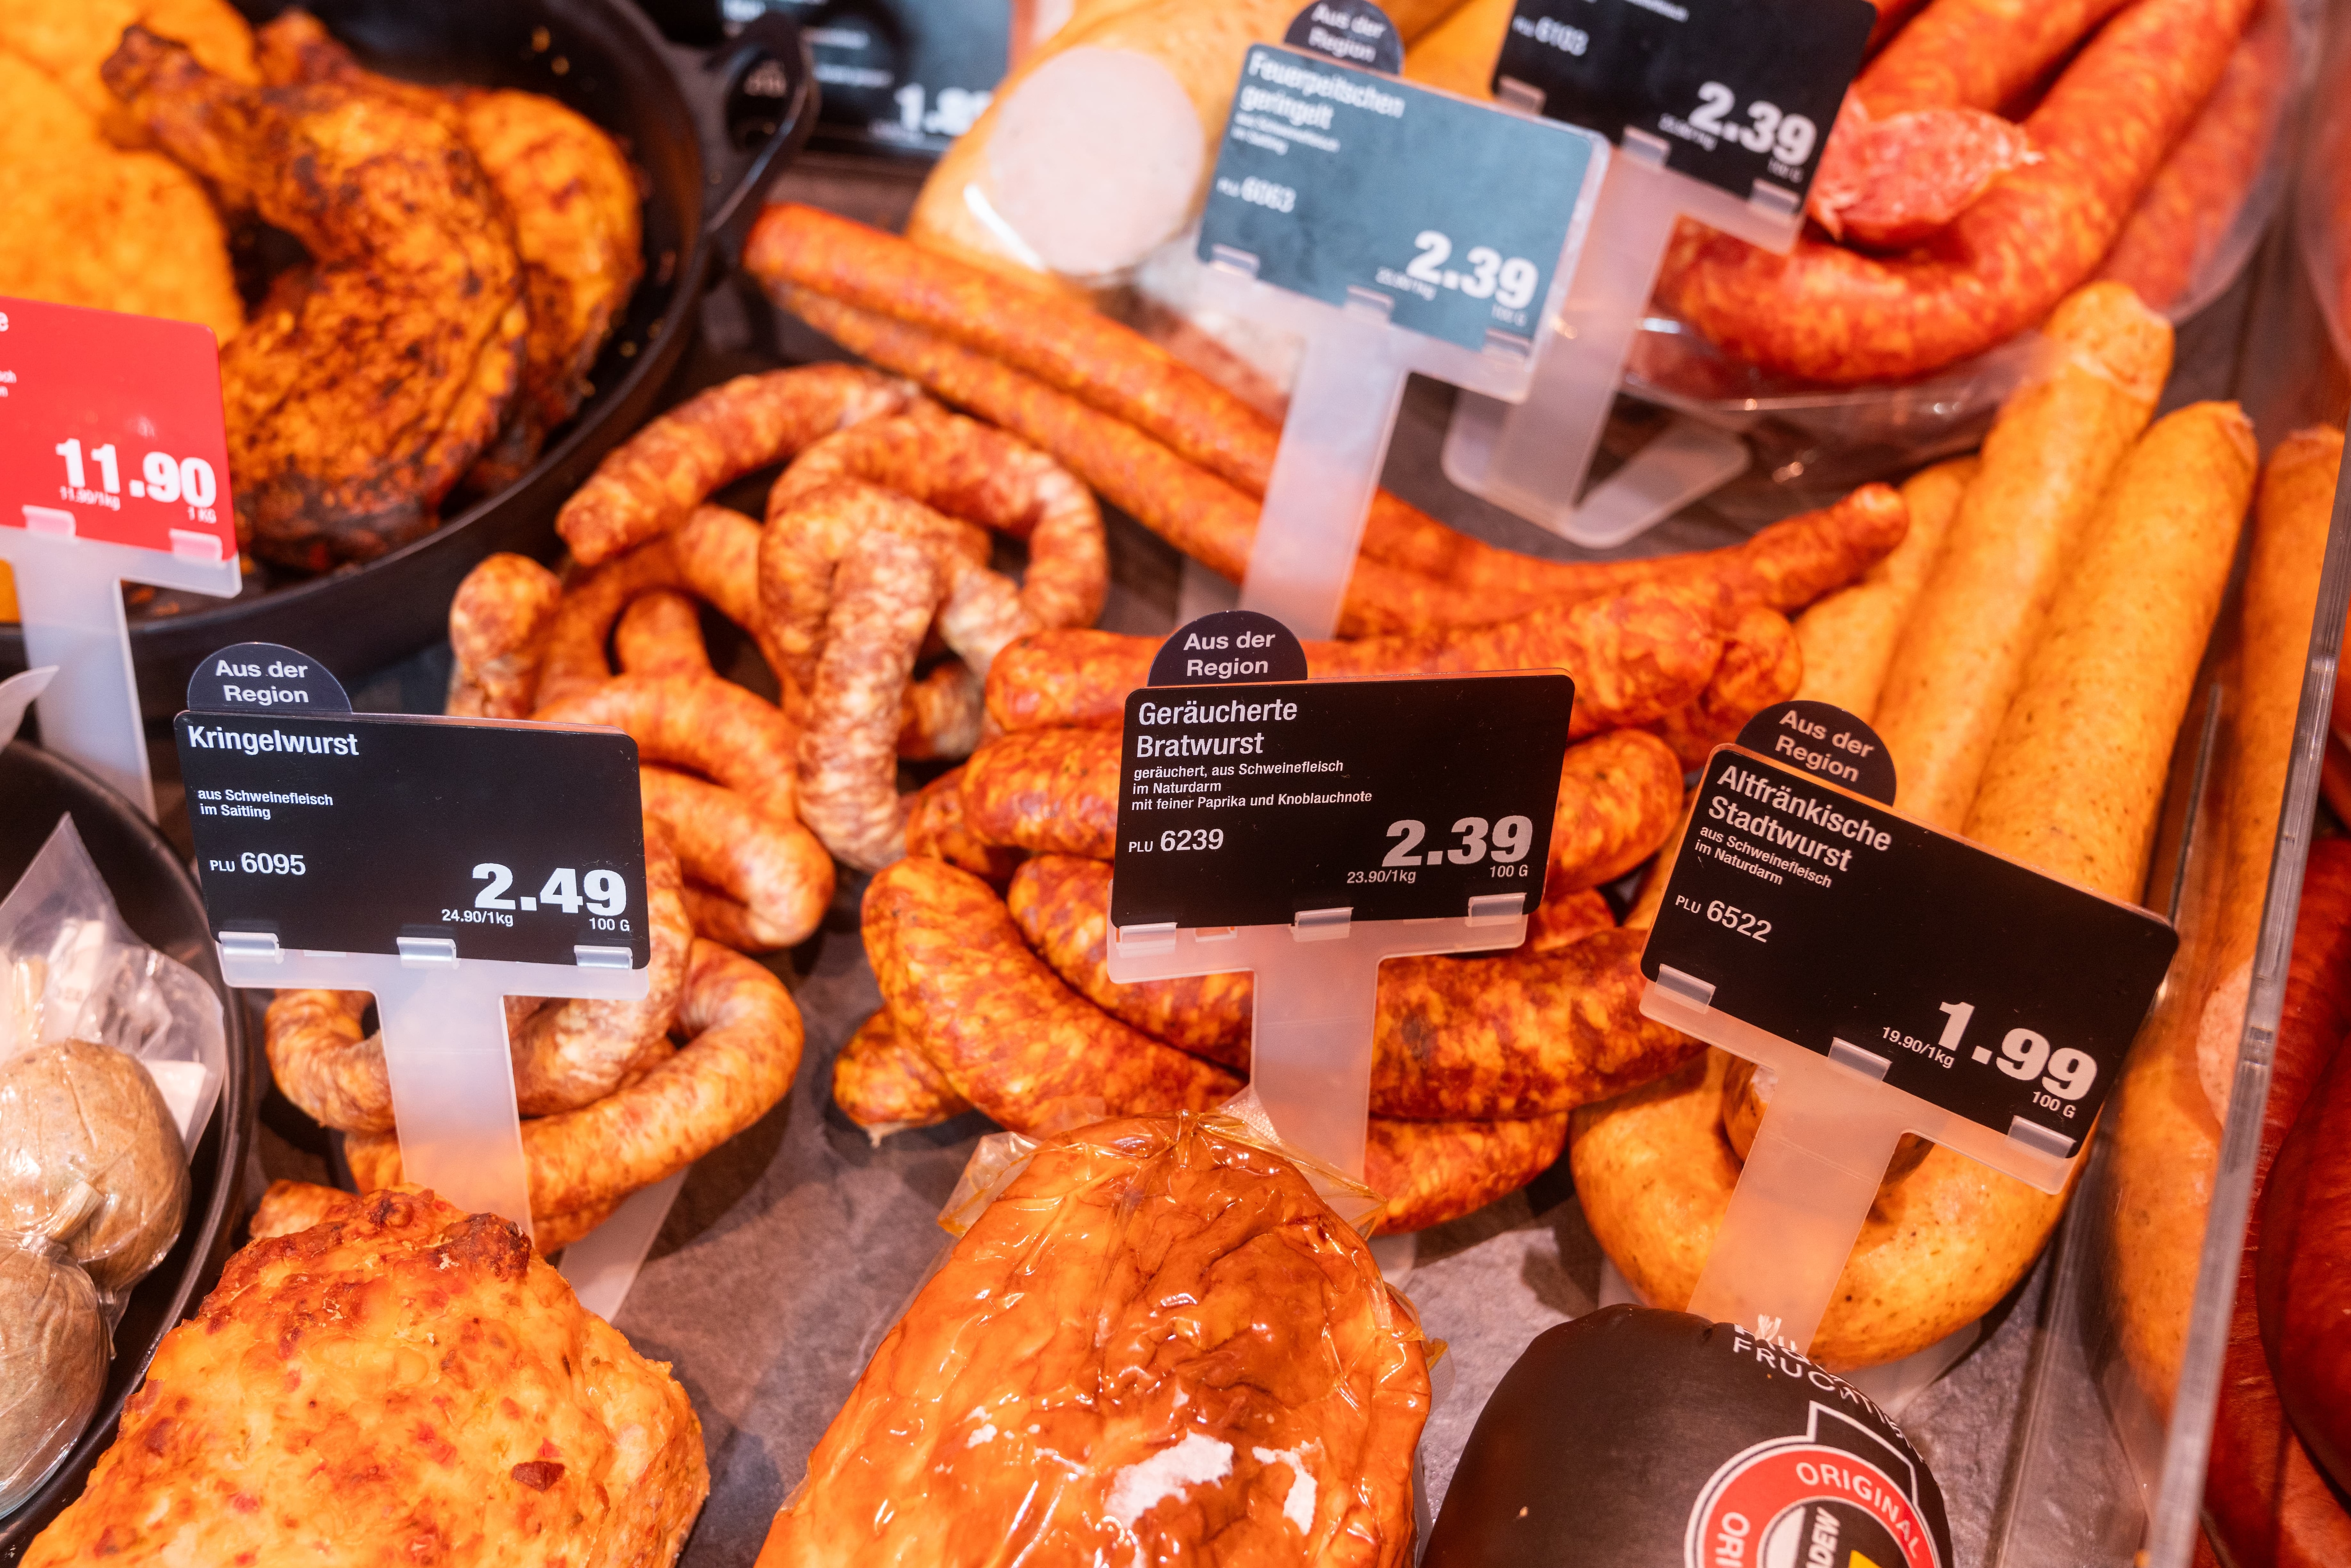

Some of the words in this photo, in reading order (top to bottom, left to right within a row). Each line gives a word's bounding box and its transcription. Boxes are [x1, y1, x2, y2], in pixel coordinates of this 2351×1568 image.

[1308, 26, 1376, 62] Region
[1688, 81, 1817, 166] 2.39
[1406, 230, 1539, 309] 2.39
[55, 438, 217, 508] 11.90
[1183, 633, 1229, 651] Aus
[1236, 631, 1276, 648] der
[215, 660, 262, 677] Aus
[268, 661, 308, 678] der
[1187, 659, 1268, 679] Region
[223, 685, 309, 706] Region
[1139, 699, 1297, 725] Geräucherte
[188, 725, 359, 756] Kringelwurst
[1136, 732, 1264, 757] Bratwurst
[1779, 710, 1827, 740] Aus
[1832, 732, 1874, 757] der
[1134, 765, 1207, 781] geräuchert,
[1212, 766, 1235, 776] aus
[1239, 760, 1343, 775] Schweinefleisch
[1775, 735, 1859, 782] Region
[197, 790, 222, 800] aus
[225, 789, 333, 806] Schweinefleisch
[1132, 798, 1152, 811] mit
[1156, 797, 1194, 810] feiner
[1198, 796, 1246, 810] Paprika
[1250, 794, 1274, 806] und
[1278, 791, 1372, 805] Knoblauchnote
[1133, 783, 1149, 795] im
[1153, 781, 1222, 794] Naturdarm
[200, 803, 217, 815] im
[221, 804, 271, 820] Saitling
[1717, 765, 1891, 851] Altfränkische
[1128, 841, 1153, 852] PLU
[1160, 828, 1224, 851] 6239
[1381, 815, 1533, 867] 2.39
[1709, 796, 1852, 872] Stadtwurst
[210, 859, 236, 872] PLU
[241, 852, 306, 875] 6095
[1347, 869, 1416, 884] 23.90/1kg
[1490, 865, 1515, 878] 100
[1519, 864, 1528, 877] G
[1695, 839, 1712, 855] im
[1714, 848, 1783, 885] Naturdarm
[1700, 827, 1724, 843] aus
[1726, 835, 1832, 888] Schweinefleisch
[472, 863, 627, 916] 2.49
[442, 909, 513, 927] 24.90/1kg
[589, 917, 615, 930] 100
[620, 919, 630, 932] G
[1675, 895, 1701, 914] PLU
[1707, 900, 1772, 943] 6522
[1938, 1001, 2098, 1101] 1.99
[1883, 1027, 1955, 1069] 19.90/1kg
[2033, 1091, 2061, 1111] 100
[2063, 1104, 2076, 1119] G
[1796, 1462, 1918, 1560] ORIGINAL
